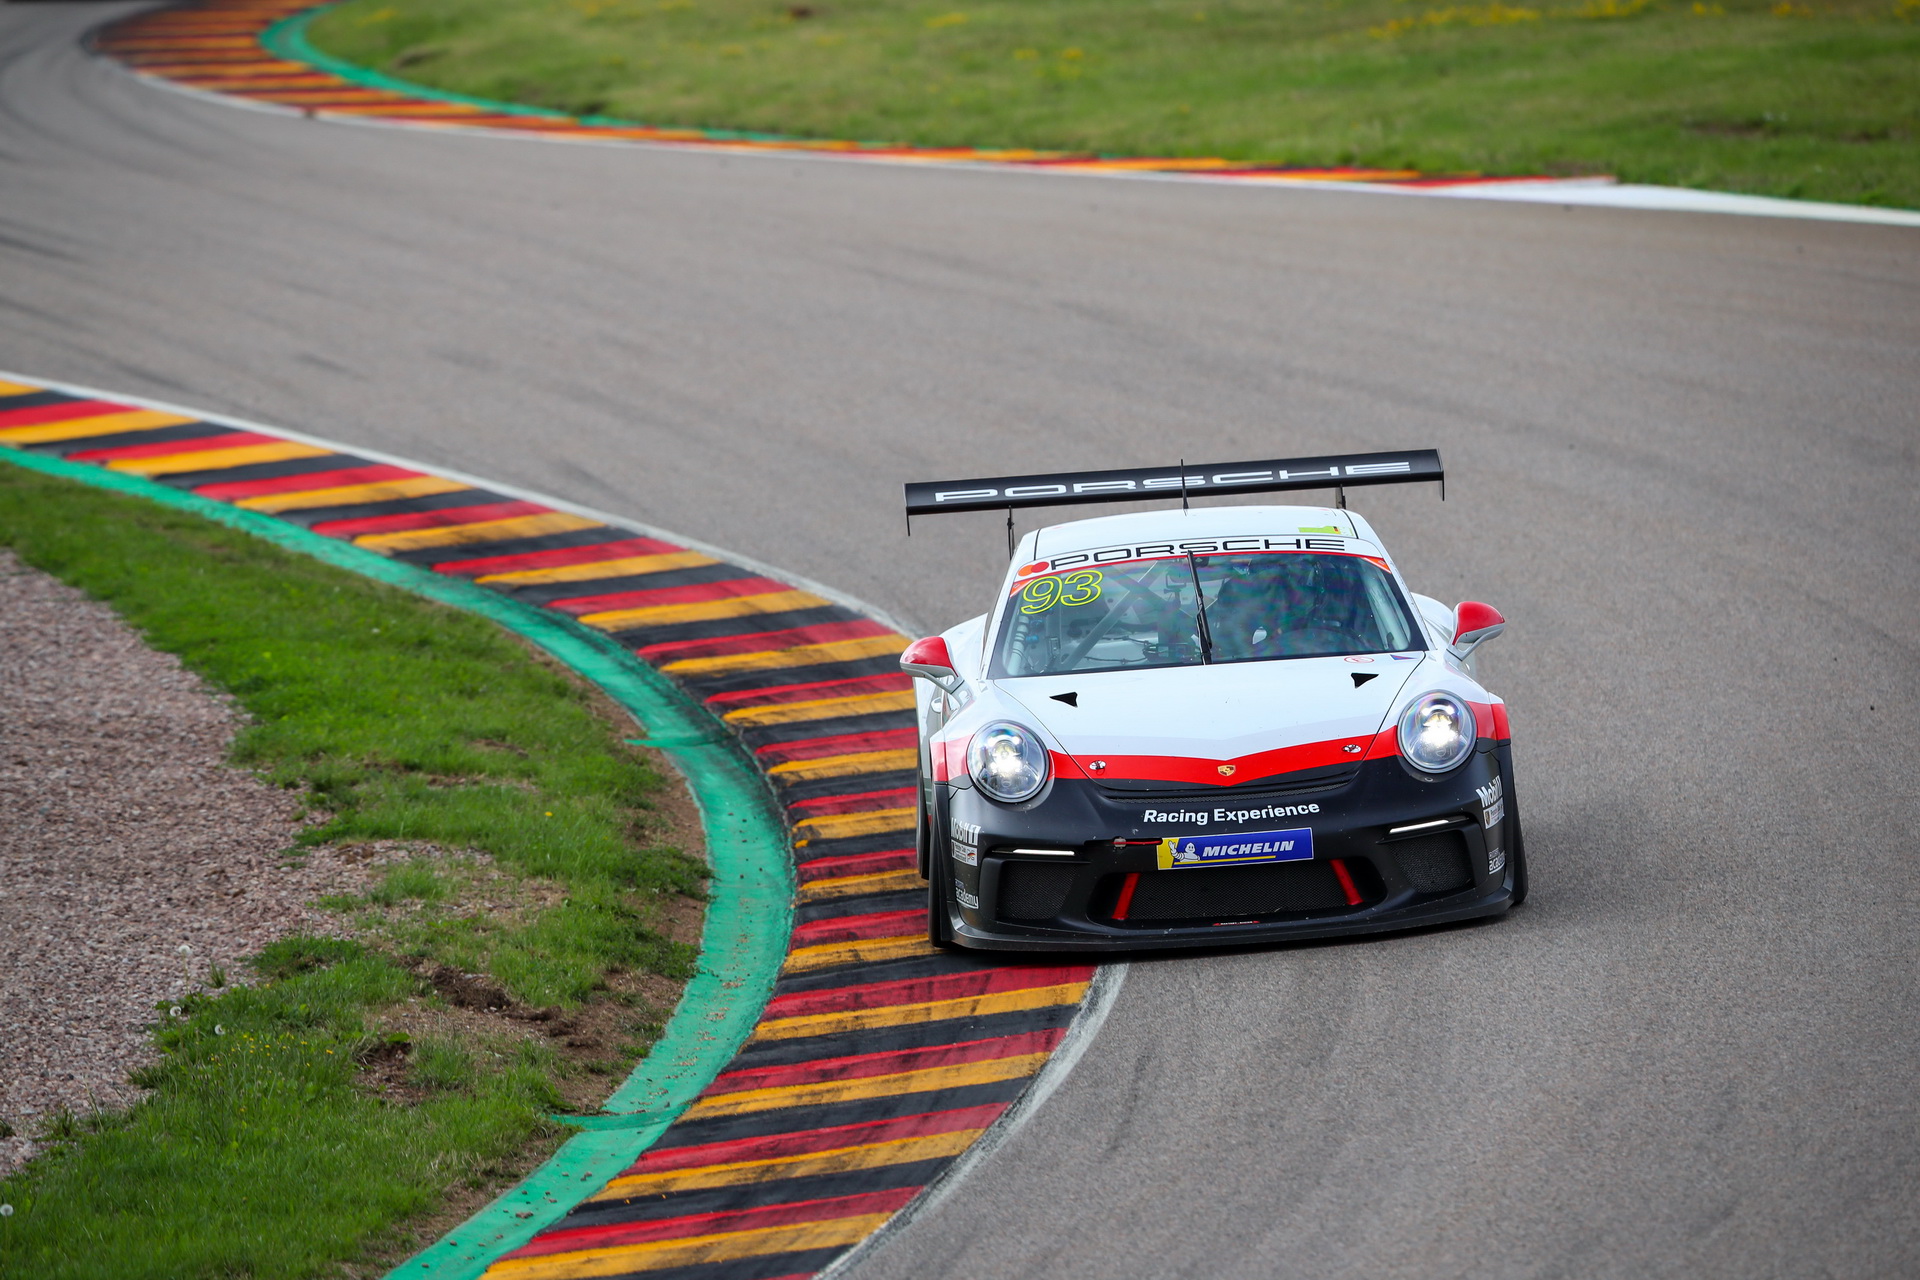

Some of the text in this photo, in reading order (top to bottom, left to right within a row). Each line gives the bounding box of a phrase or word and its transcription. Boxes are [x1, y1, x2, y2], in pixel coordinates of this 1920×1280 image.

[935, 461, 1411, 502] PORSCHE
[1050, 538, 1345, 571] PORSCHE
[1021, 570, 1103, 614] 93
[1143, 803, 1320, 826] Racing Experience
[1202, 840, 1295, 857] MICHELIN
